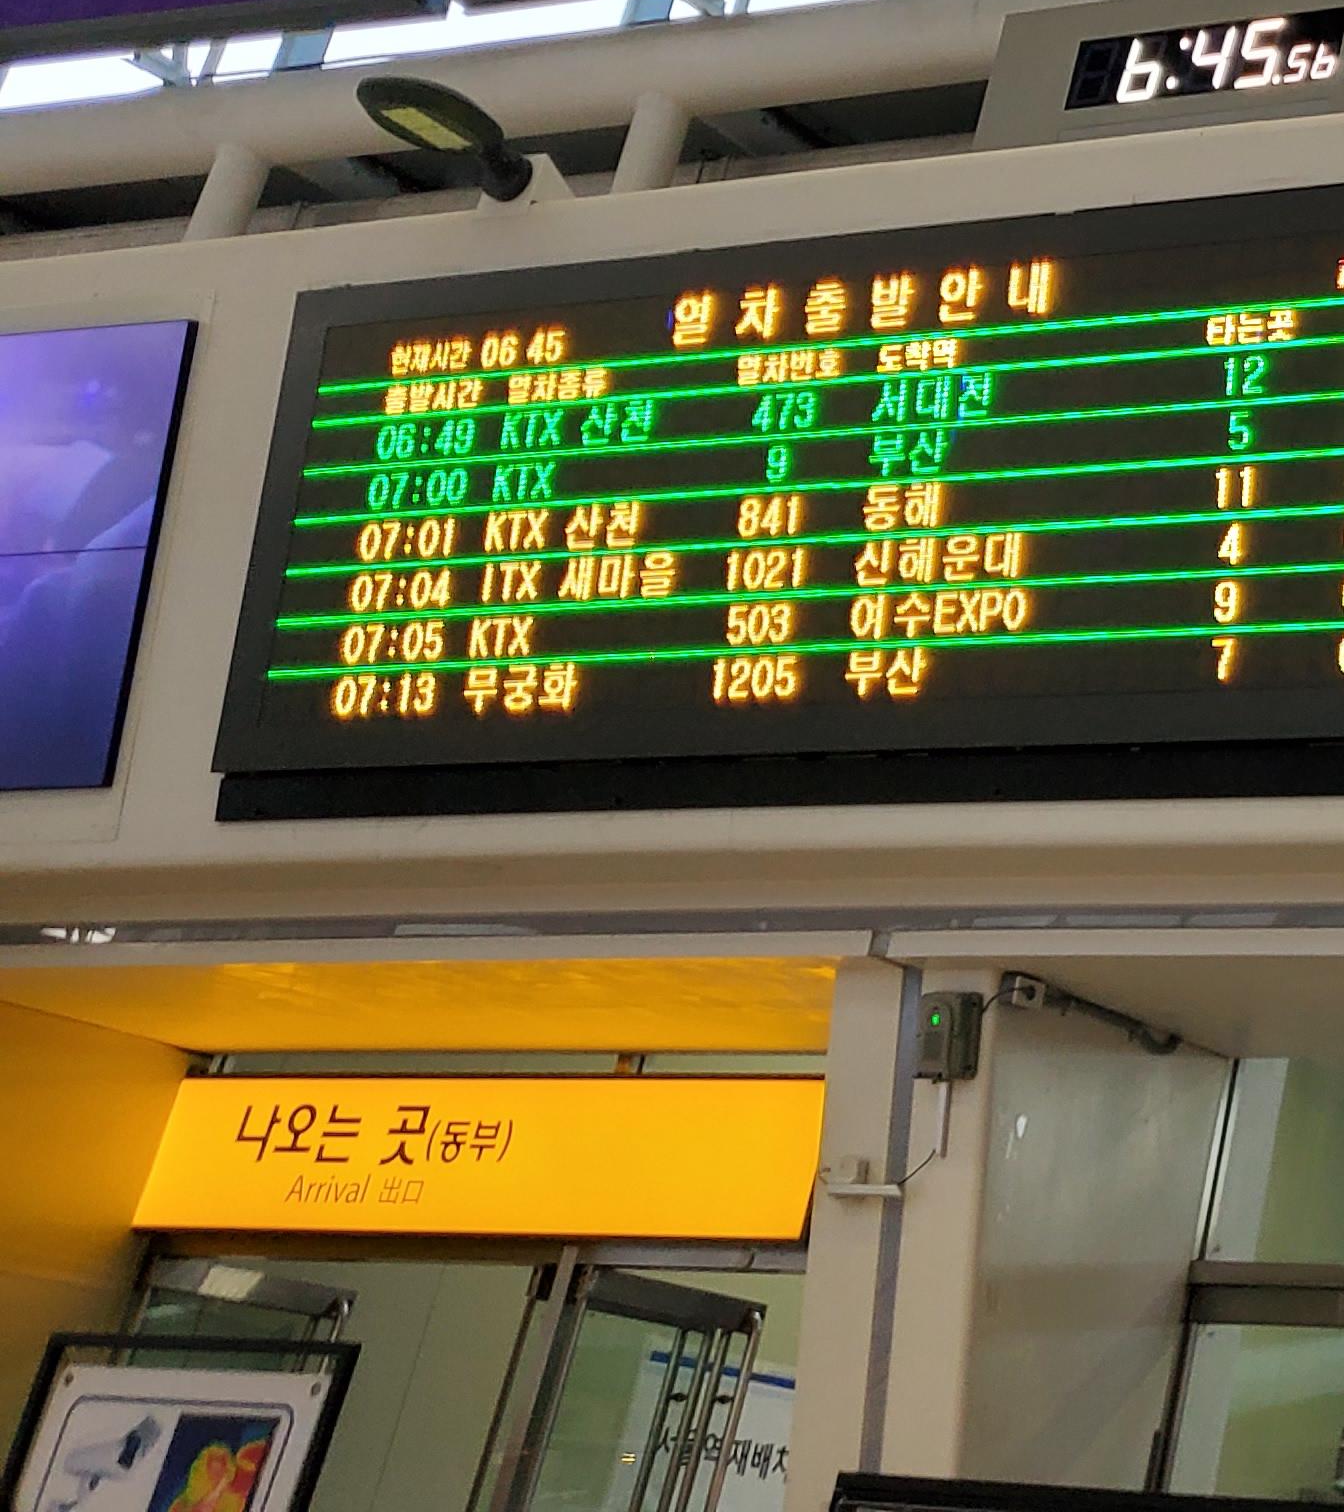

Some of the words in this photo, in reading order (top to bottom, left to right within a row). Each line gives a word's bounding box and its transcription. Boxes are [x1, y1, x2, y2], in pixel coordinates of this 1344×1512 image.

[384, 379, 484, 415] 출발시간
[508, 368, 608, 406] 열차종류
[737, 349, 841, 387] 열차번호
[877, 339, 958, 373] 도착역
[1206, 308, 1295, 346] 타는곳
[390, 338, 472, 376] 현재시간
[376, 419, 476, 460] 06:49
[500, 409, 565, 448] KTX
[580, 400, 655, 445] 산천
[751, 392, 817, 432] 473
[872, 370, 992, 423] 서대전
[1224, 355, 1266, 396] 12
[367, 468, 468, 510] 07:00
[491, 462, 556, 501] KTX
[766, 444, 788, 482] 9
[869, 429, 947, 477] 부산
[1227, 410, 1250, 451] 5
[359, 517, 455, 561] 07:01
[484, 508, 549, 552] KTX
[564, 501, 641, 548] 산천
[738, 495, 800, 538] 841
[863, 482, 943, 531] 동해
[1216, 465, 1256, 509] 11
[351, 567, 451, 611] 07:04
[480, 560, 542, 602] ITX
[557, 551, 677, 600] 새마을
[727, 548, 804, 591] 1021
[854, 532, 1023, 587] 신해운대
[1217, 523, 1242, 565] 4
[342, 620, 445, 665] 07:05
[468, 616, 534, 658] KTX
[726, 602, 792, 646] 503
[850, 589, 1027, 639] 여수EXPO
[1213, 580, 1240, 624] 9
[333, 672, 437, 718] 07:13
[463, 662, 577, 714] 무궁화
[713, 655, 797, 700] 1205
[845, 647, 927, 697] 부산
[1211, 636, 1237, 680] 7
[235, 1104, 362, 1163] 나오는
[285, 1173, 371, 1204] Arrival
[378, 1176, 424, 1204] 出口
